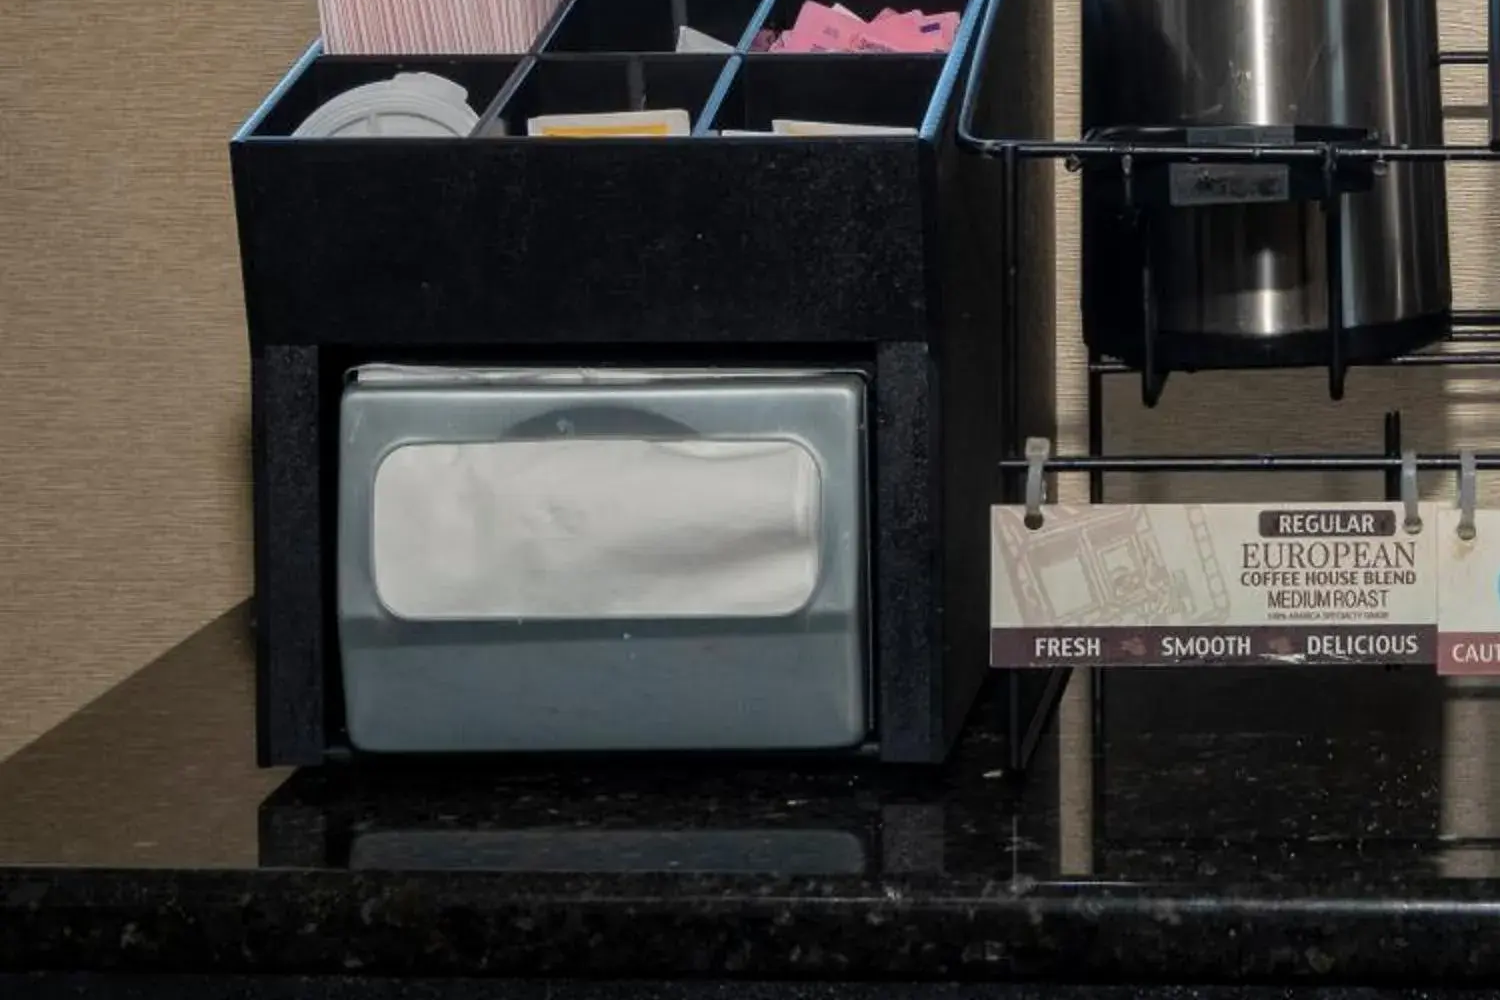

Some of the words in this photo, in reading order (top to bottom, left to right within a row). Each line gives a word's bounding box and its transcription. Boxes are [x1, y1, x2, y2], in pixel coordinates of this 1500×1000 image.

[1278, 514, 1375, 533] REGULAR
[1241, 541, 1416, 569] EUROPEAN
[1240, 571, 1301, 587] COFFEE
[1305, 571, 1359, 587] HOUSE
[1363, 570, 1416, 586] BLEND
[1267, 590, 1331, 609] MEDIUM
[1333, 590, 1390, 609] ROAST
[1035, 638, 1100, 657] FRESH
[1161, 636, 1251, 657] SMOOTH
[1307, 635, 1418, 655] DELICIOUS
